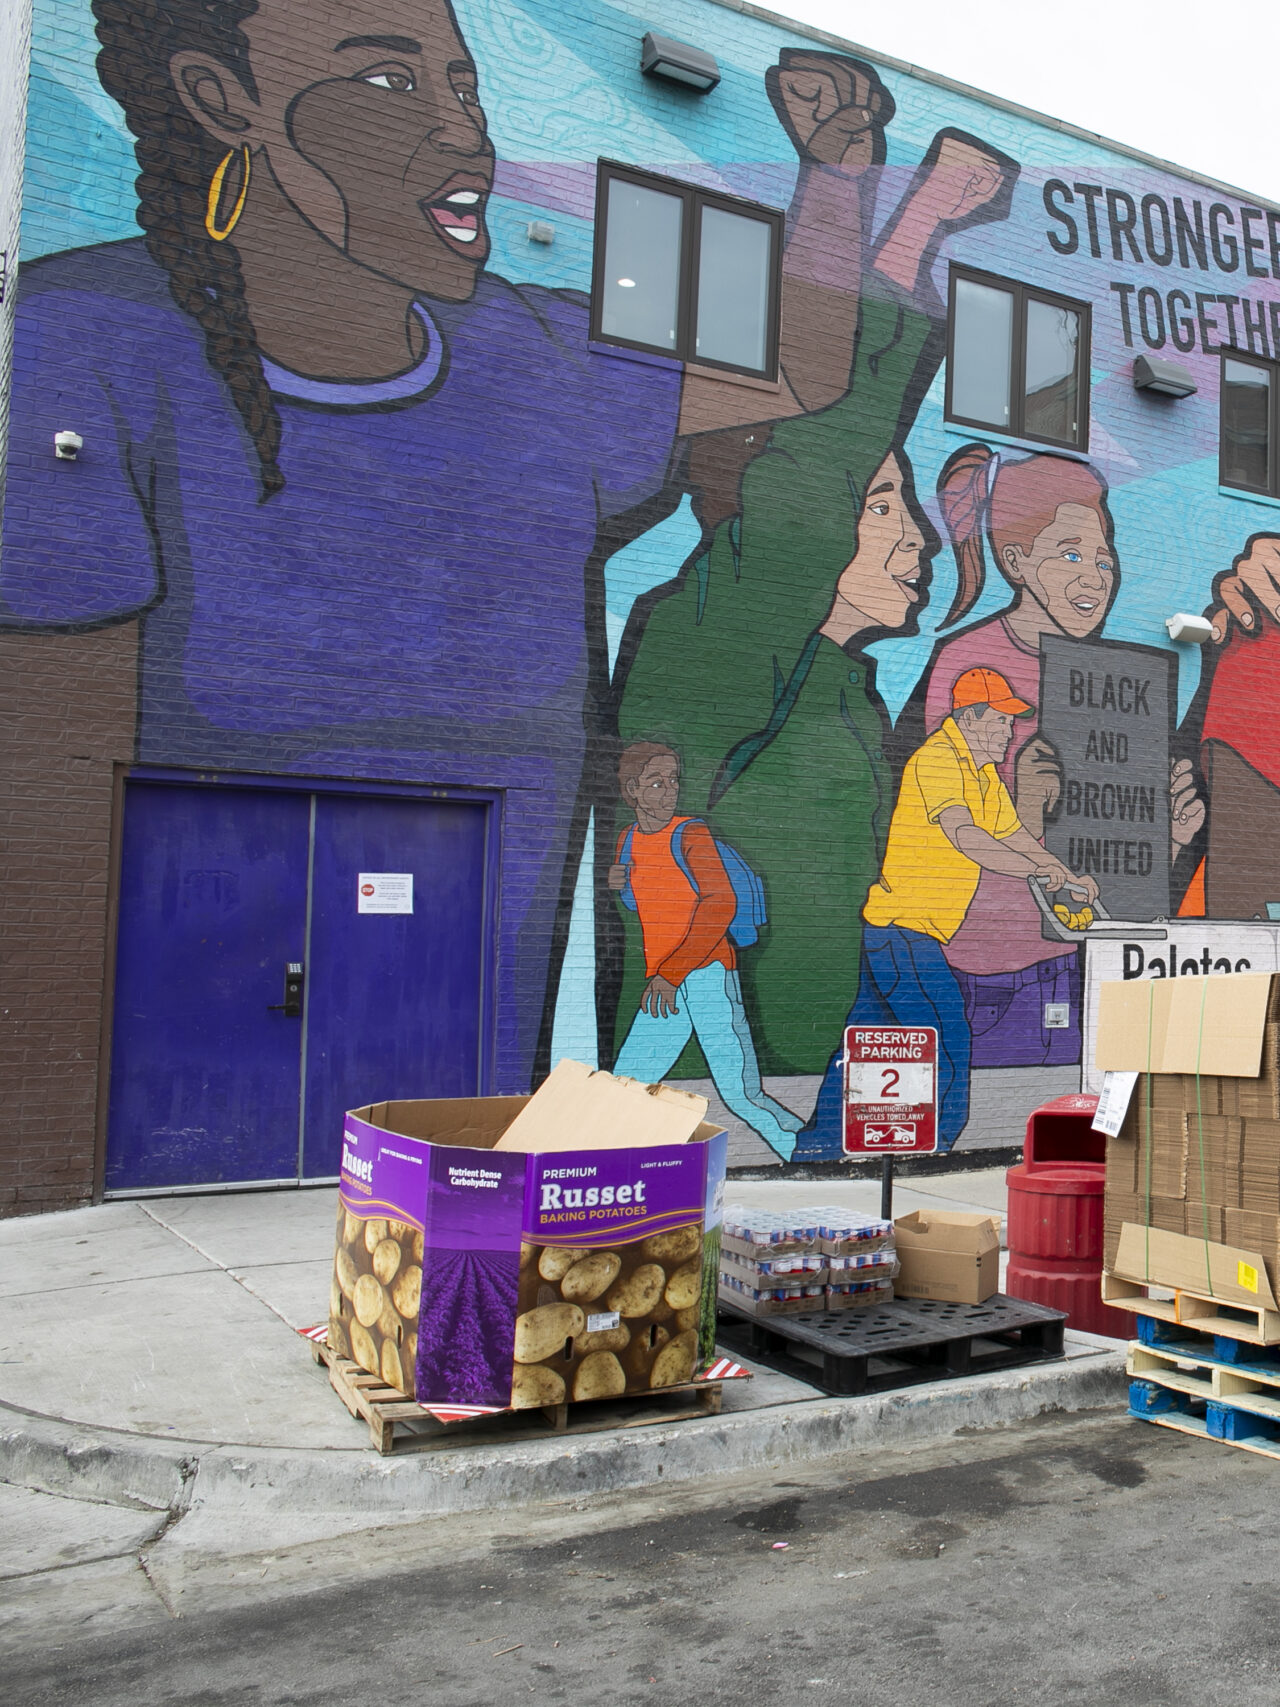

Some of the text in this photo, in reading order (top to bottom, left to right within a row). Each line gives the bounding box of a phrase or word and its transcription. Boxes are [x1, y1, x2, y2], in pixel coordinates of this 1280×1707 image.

[1069, 669, 1150, 716] BLACK
[1085, 729, 1129, 764] AND
[1066, 780, 1155, 823] BROWN
[1068, 837, 1152, 877] UNITED
[1122, 943, 1251, 981] Palta
[855, 1032, 928, 1044] RESERVED
[861, 1046, 922, 1059] PARKING
[880, 1068, 900, 1098] 2
[856, 1113, 925, 1121] VEHICLES TOWED AWAY
[342, 1142, 374, 1183] Russet
[448, 1166, 502, 1180] Nutrient Dense
[543, 1166, 597, 1180] PREMIUM
[640, 1161, 657, 1169] LIGHT
[450, 1176, 499, 1189] Carbohydrate
[539, 1180, 647, 1211] Russet
[540, 1205, 648, 1224] BAKING POTATOES
